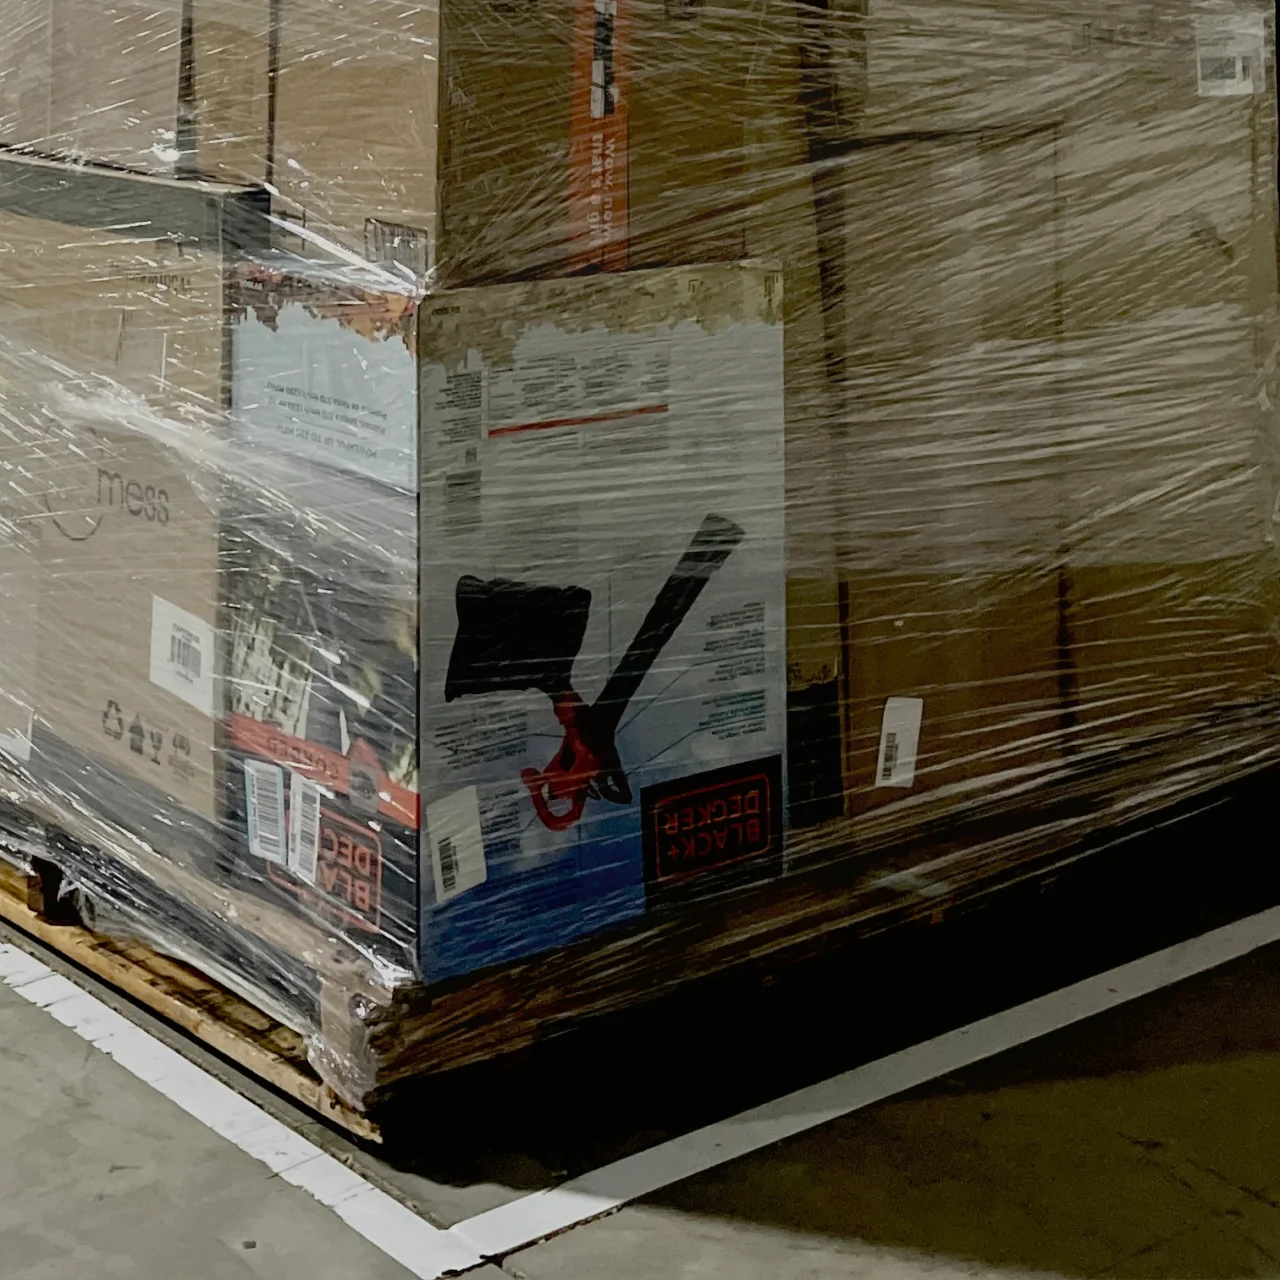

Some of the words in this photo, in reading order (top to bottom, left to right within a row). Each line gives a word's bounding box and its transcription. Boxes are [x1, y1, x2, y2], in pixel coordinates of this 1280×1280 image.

[662, 789, 761, 836] DECKER
[320, 827, 371, 876] DEC
[667, 818, 761, 861] BLACK+
[317, 862, 371, 912] BLA
